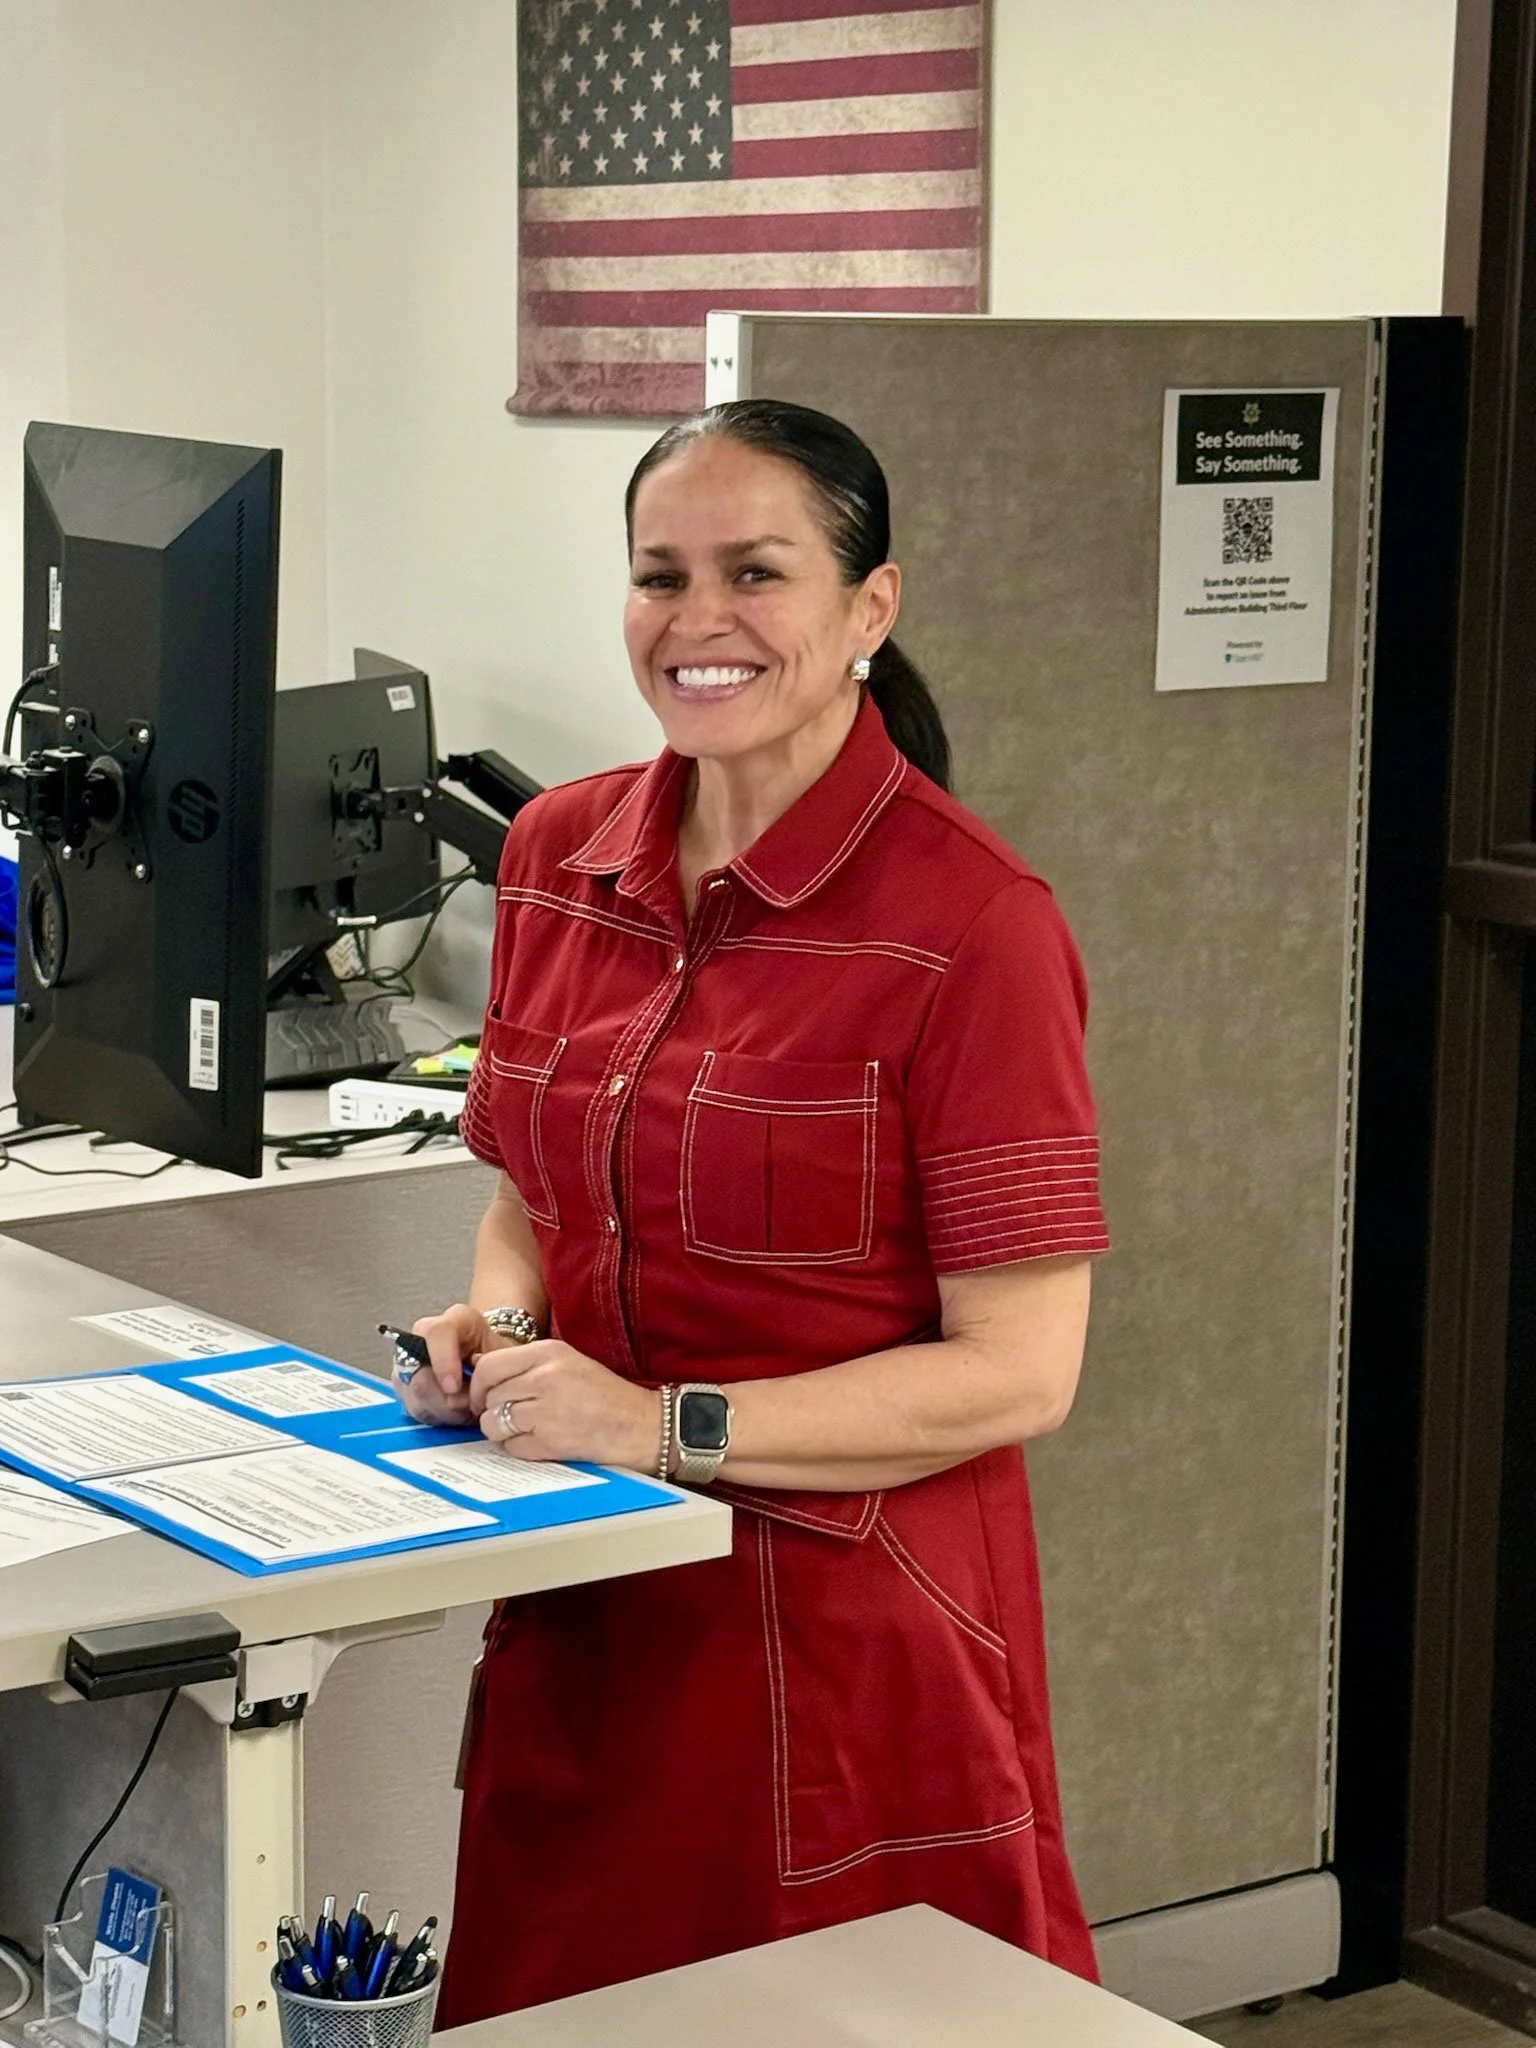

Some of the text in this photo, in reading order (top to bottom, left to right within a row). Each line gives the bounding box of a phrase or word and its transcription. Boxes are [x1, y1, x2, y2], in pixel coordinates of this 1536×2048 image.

[1196, 431, 1222, 449] See
[1196, 456, 1222, 476] Say
[1203, 576, 1290, 587] Scan the QR Code above
[1216, 592, 1238, 600] report
[1269, 588, 1286, 597] from
[1184, 602, 1308, 615] Administrative Building Third Floor
